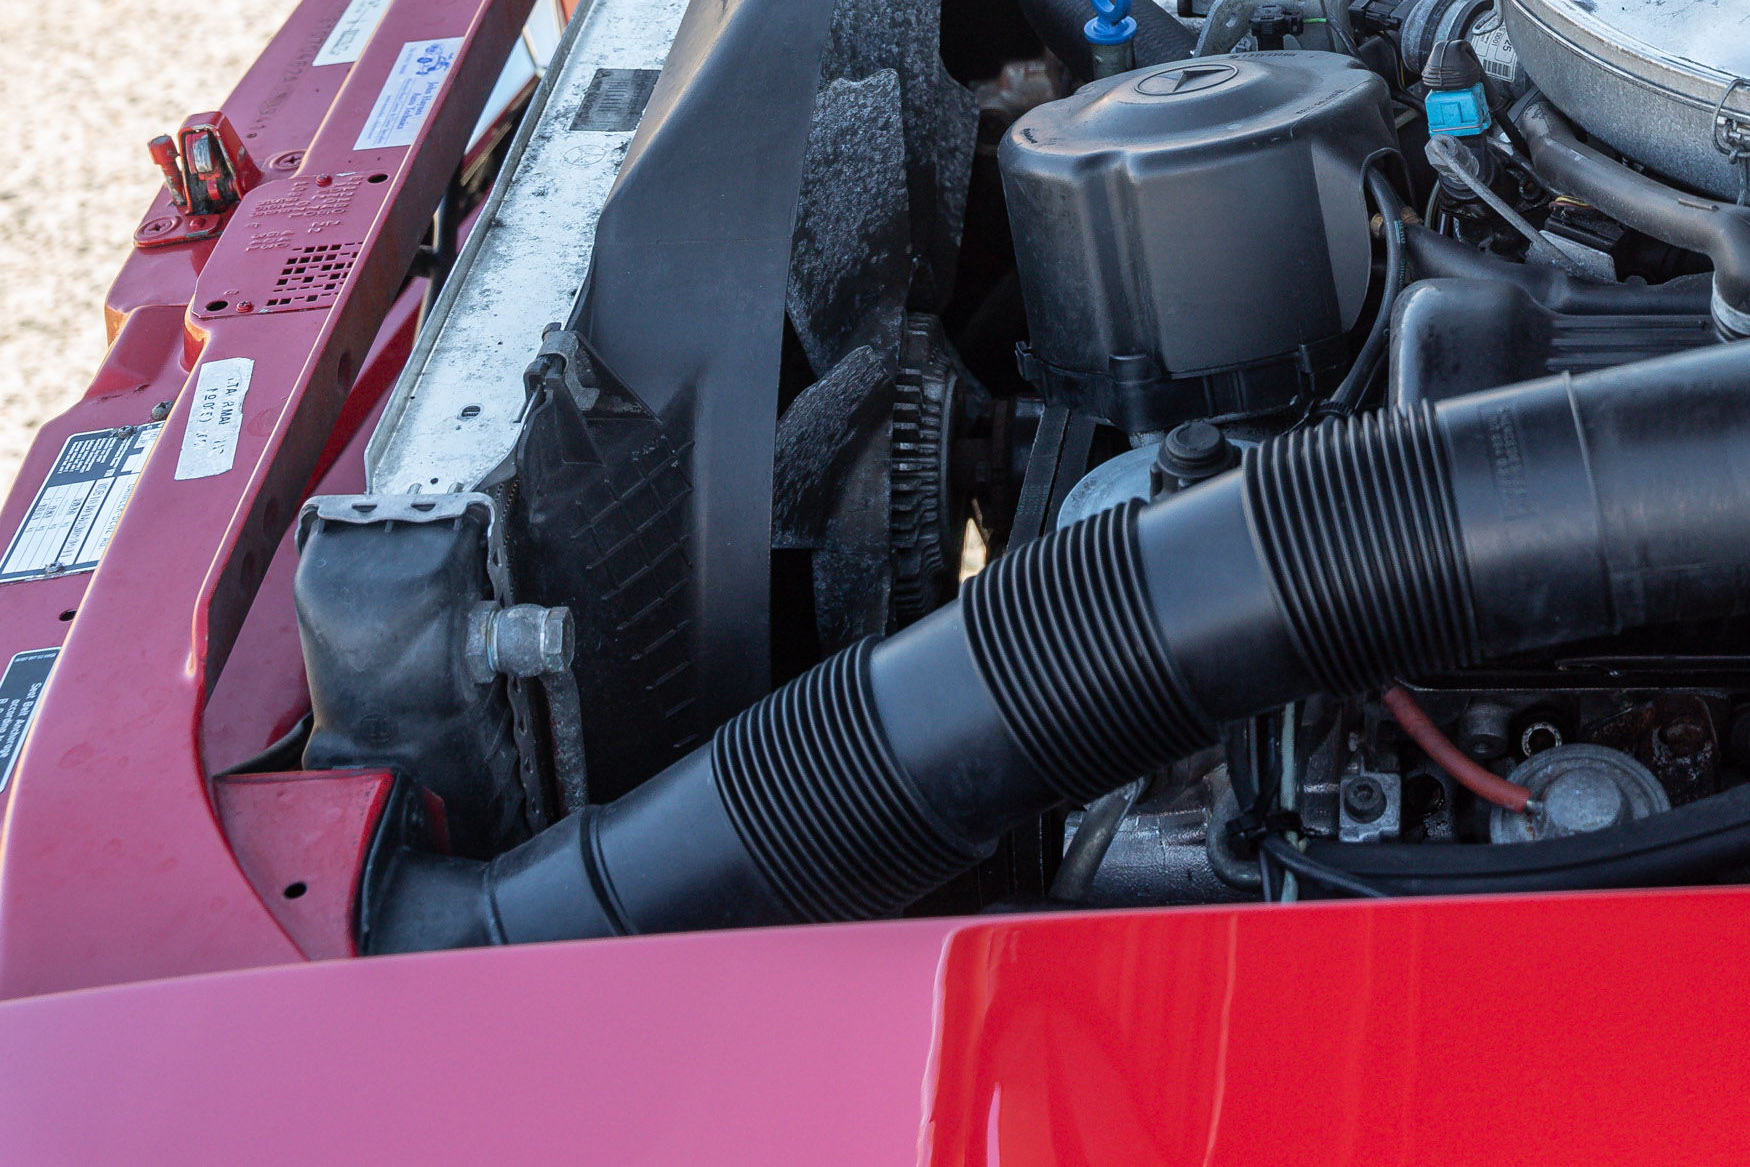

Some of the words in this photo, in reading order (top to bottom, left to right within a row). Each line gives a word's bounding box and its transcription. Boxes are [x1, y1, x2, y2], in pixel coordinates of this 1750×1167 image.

[26, 682, 42, 699] Seat
[18, 701, 34, 716] Belt
[0, 719, 25, 757] Anchorage
